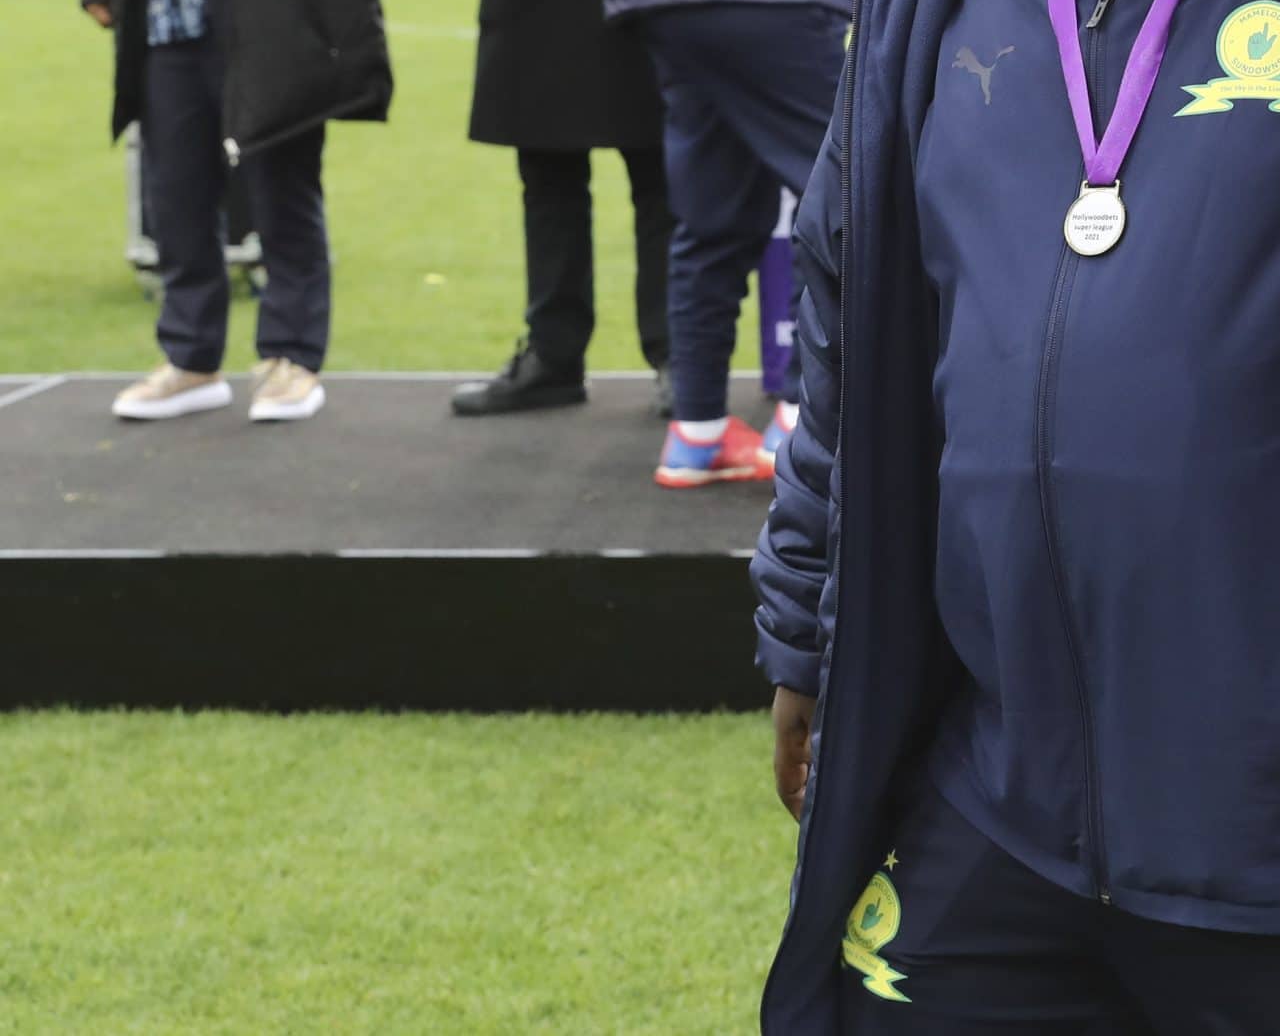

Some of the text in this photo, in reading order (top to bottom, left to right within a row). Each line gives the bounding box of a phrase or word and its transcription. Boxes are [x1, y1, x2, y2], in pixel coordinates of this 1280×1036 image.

[1072, 212, 1119, 222] Hollywoodbets
[1074, 223, 1114, 232] super league
[1084, 233, 1100, 241] 2021
